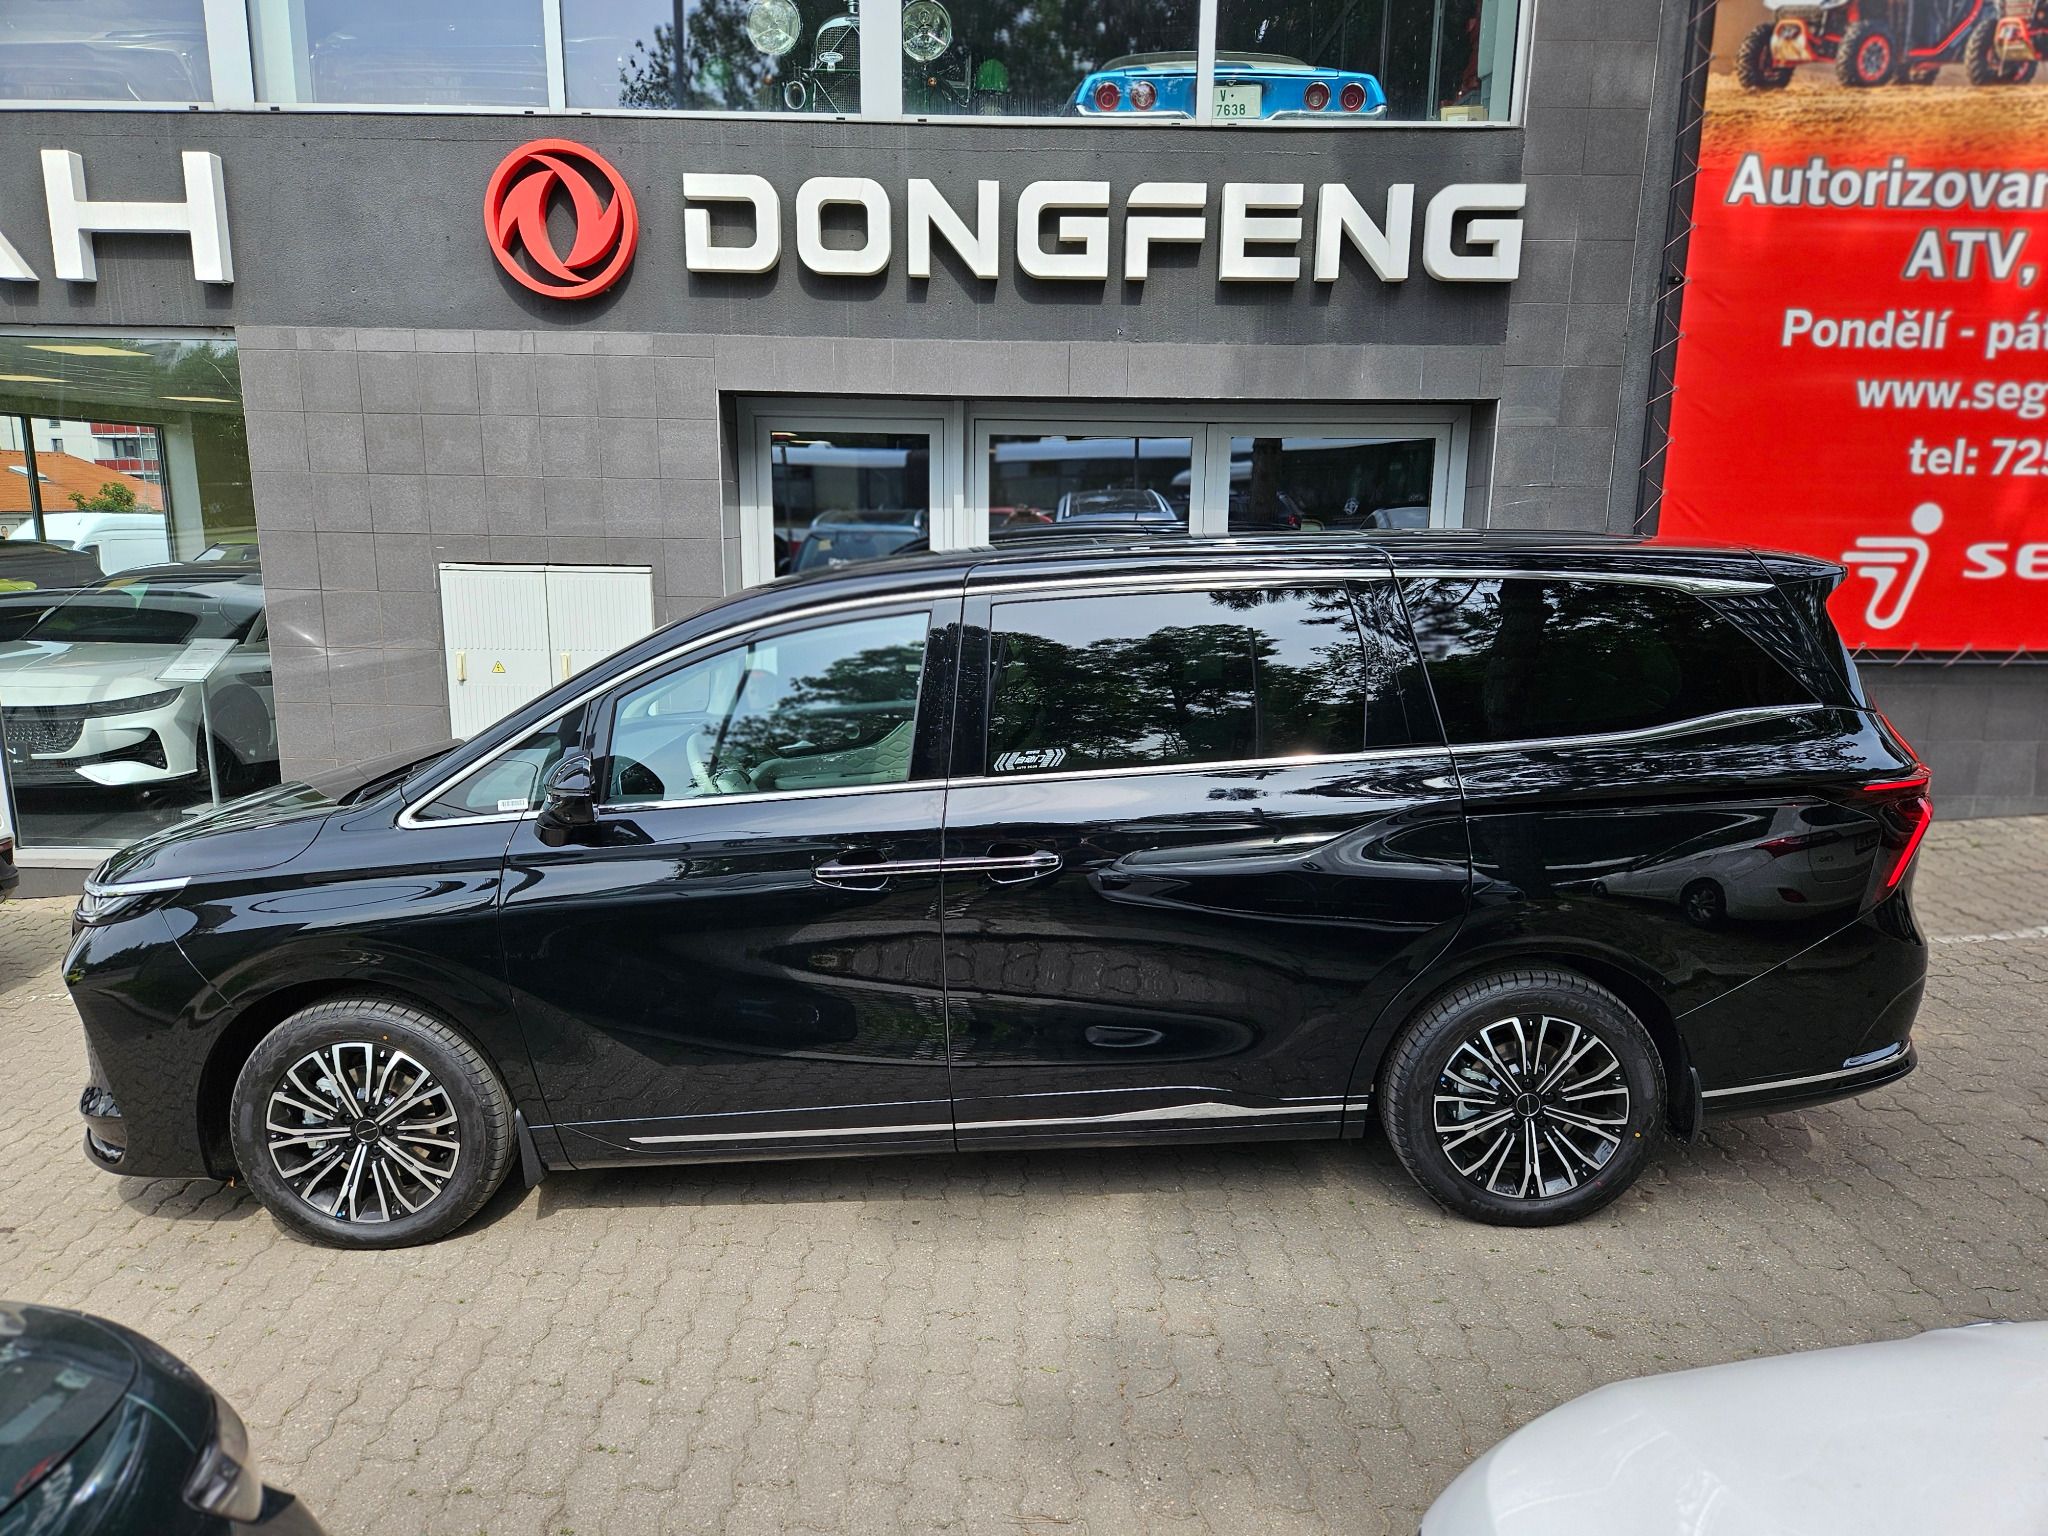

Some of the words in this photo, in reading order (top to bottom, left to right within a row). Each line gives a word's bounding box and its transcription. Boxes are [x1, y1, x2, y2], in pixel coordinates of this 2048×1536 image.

[1216, 103, 1246, 117] 7638
[0, 149, 235, 284] H
[682, 172, 1528, 283] DONGFENG
[1902, 228, 2038, 288] ATV,
[1780, 308, 1953, 350] Pondělí
[1985, 310, 2048, 360] pá
[1908, 437, 1979, 475] tel:
